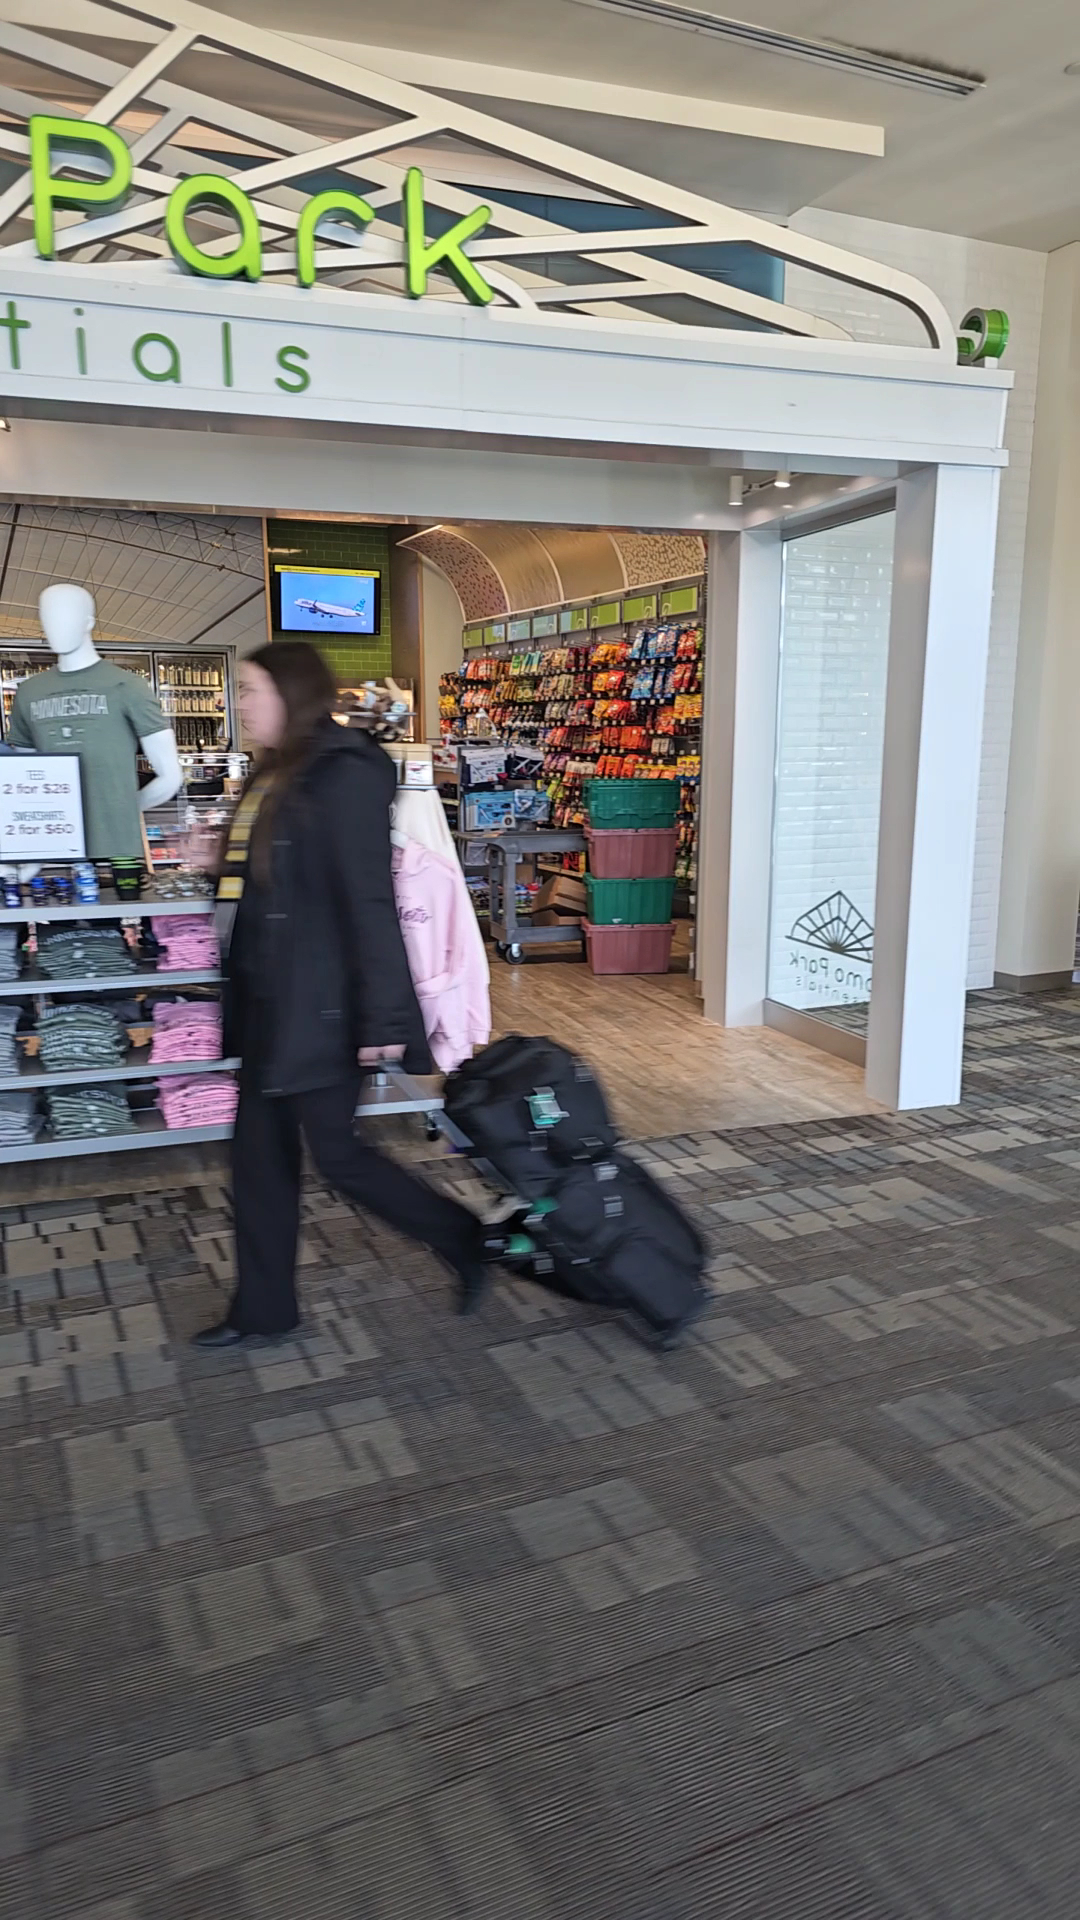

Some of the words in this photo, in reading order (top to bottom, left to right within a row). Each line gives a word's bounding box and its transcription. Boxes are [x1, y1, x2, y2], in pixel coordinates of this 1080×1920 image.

[30, 114, 494, 306] Park
[30, 694, 109, 722] MINNESOTA
[2, 783, 13, 794] 2
[16, 783, 38, 794] for
[4, 824, 16, 835] 2
[18, 823, 41, 834] for
